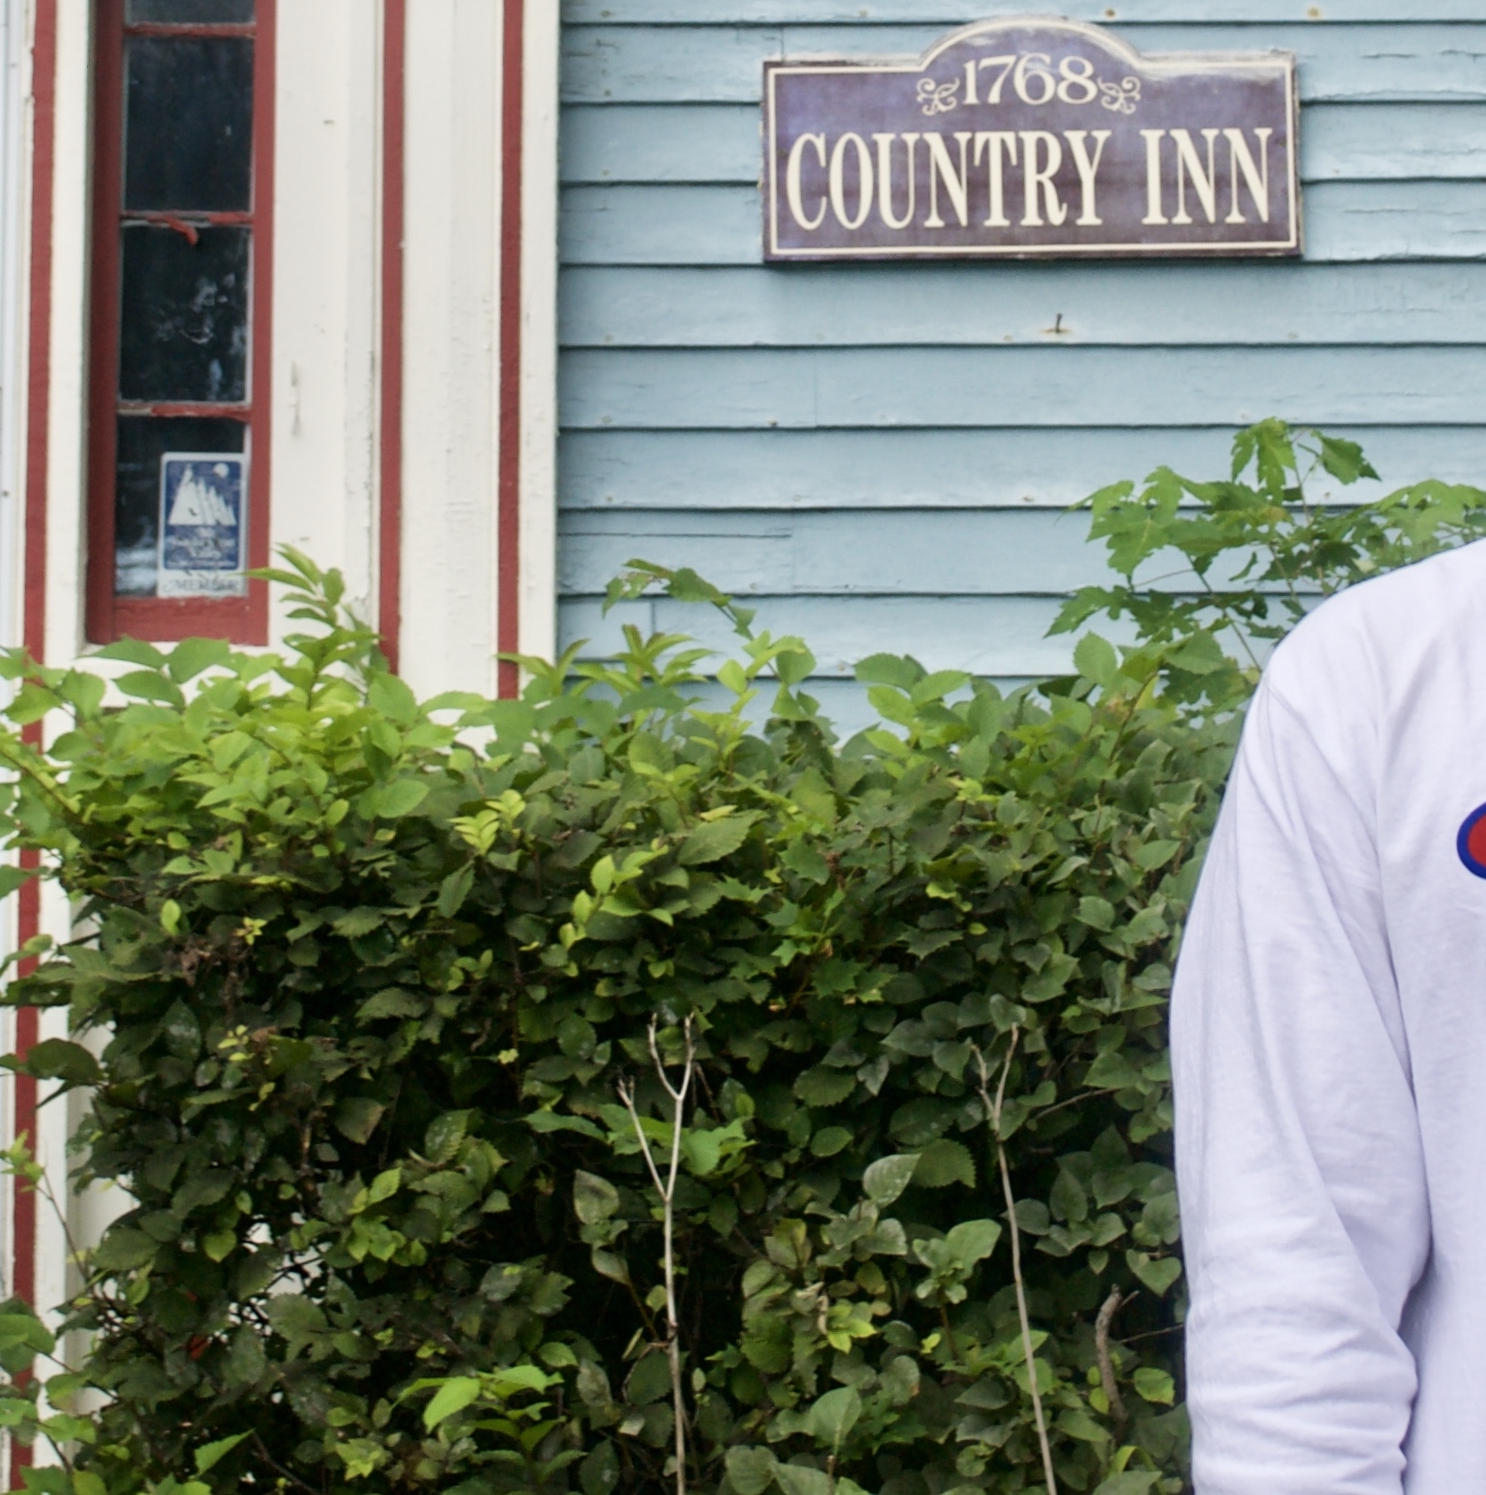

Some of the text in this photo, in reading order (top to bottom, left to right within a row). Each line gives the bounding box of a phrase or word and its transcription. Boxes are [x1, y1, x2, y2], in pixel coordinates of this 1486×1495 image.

[963, 53, 1099, 105] 1768
[786, 127, 1273, 230] COUNTRY INN
